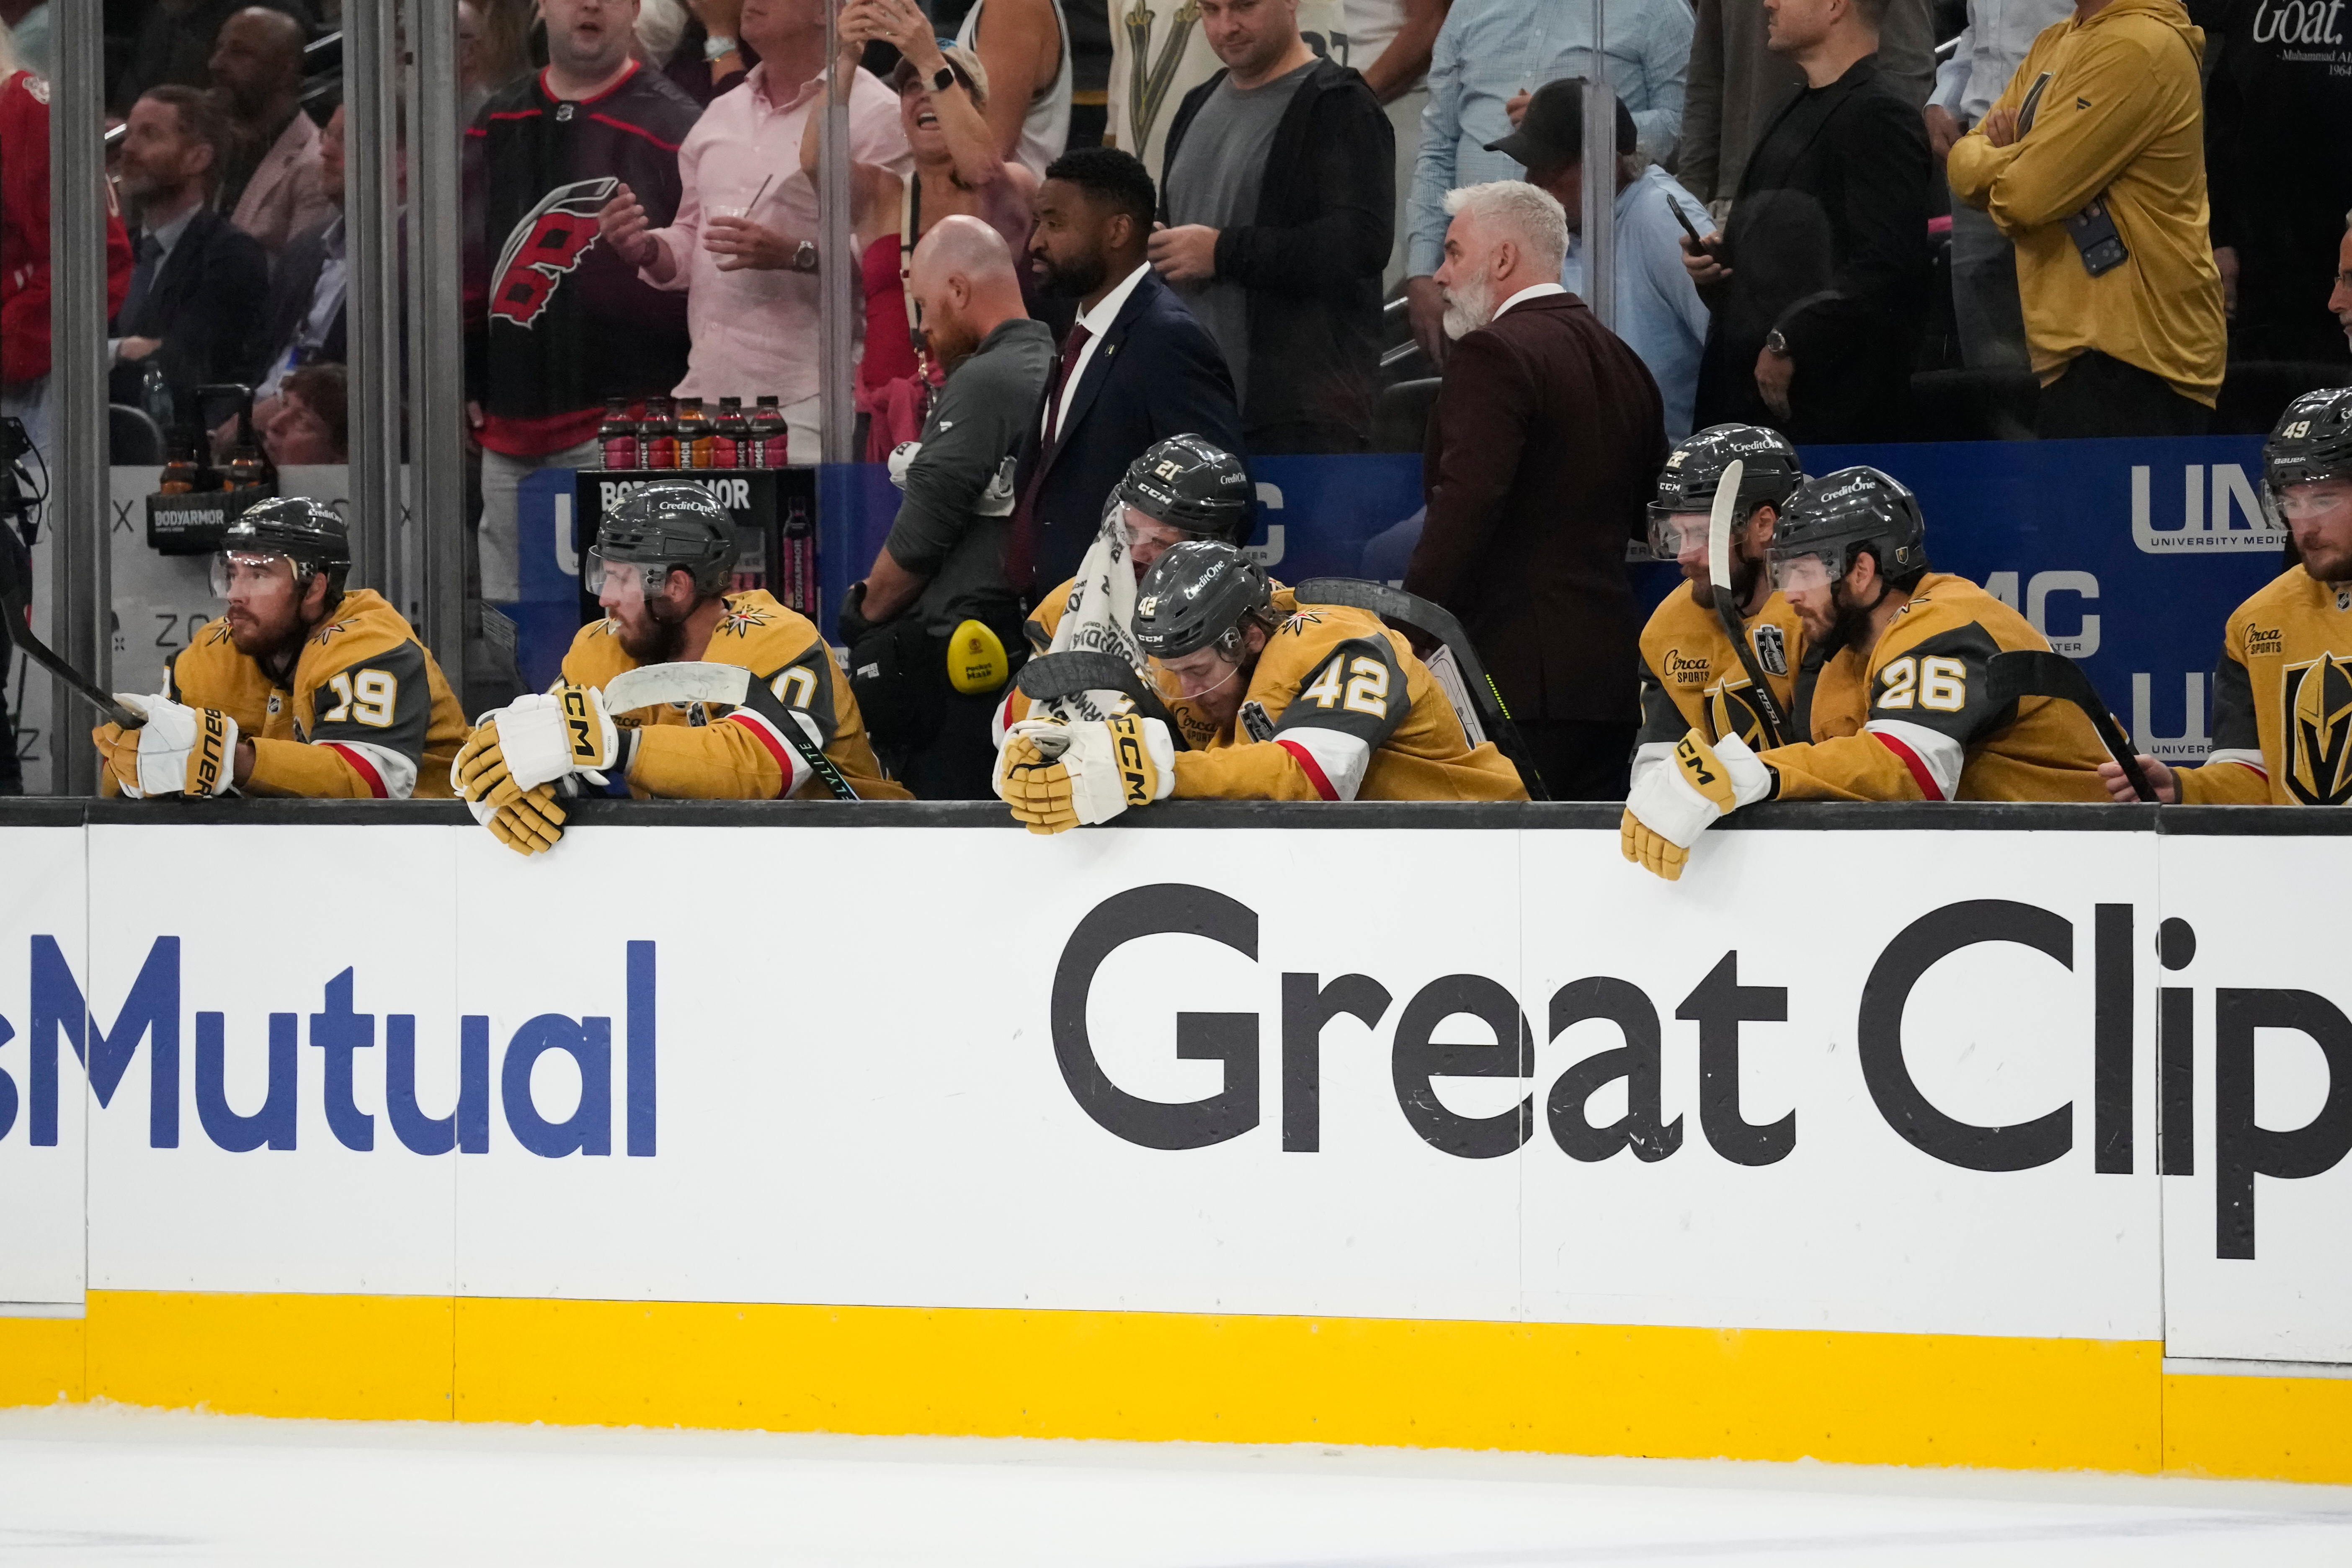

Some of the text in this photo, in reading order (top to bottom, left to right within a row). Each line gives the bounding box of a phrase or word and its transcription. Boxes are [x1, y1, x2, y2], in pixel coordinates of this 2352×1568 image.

[2337, 51, 2352, 62] Al
[2282, 420, 2311, 438] 49
[1155, 460, 1184, 481] 21
[1138, 482, 1173, 504] CCM
[1659, 482, 1681, 492] CCM
[1821, 481, 1876, 503] CreditOne
[155, 509, 224, 526] BODYARMOR
[659, 501, 714, 513] CreditOne
[2151, 535, 2288, 546] UNIVERSITY MEDIC
[1184, 560, 1225, 600] CreditOne
[1137, 596, 1158, 616] 42
[1137, 634, 1163, 642] CCM
[2244, 623, 2282, 650] Circa
[2251, 642, 2282, 654] SPORTS
[1664, 649, 1710, 676] Circa
[1301, 654, 1389, 720] 42
[1678, 671, 1710, 683] SPORTS
[1877, 655, 1967, 712] 26
[324, 668, 397, 727] 19
[564, 683, 596, 756] CM
[1676, 735, 1715, 785] CM
[2152, 745, 2213, 754] UNIVERS
[1050, 883, 2352, 1260] Great Clip
